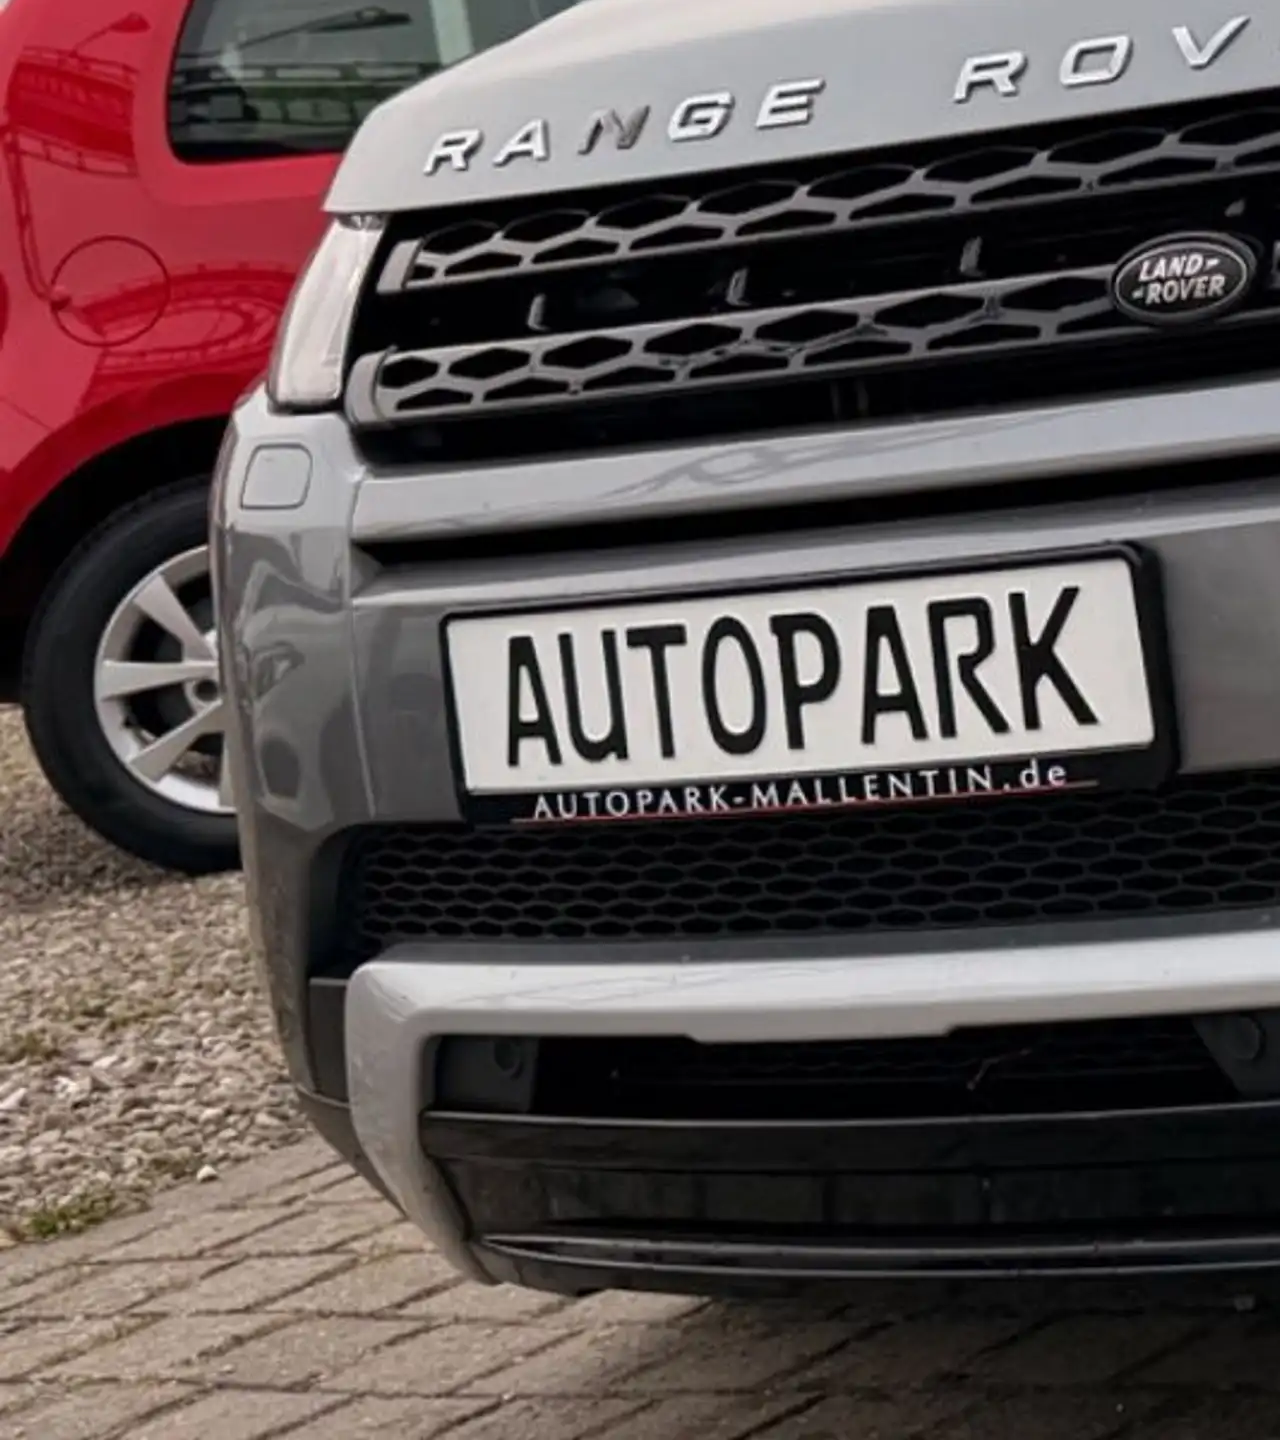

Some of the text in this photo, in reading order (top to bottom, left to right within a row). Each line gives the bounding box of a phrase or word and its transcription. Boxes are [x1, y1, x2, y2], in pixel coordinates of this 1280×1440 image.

[424, 76, 825, 174] RANGE
[506, 585, 1099, 767] AUTOPARK
[533, 760, 1069, 821] AUTOPARK-MALLENTIN.de
